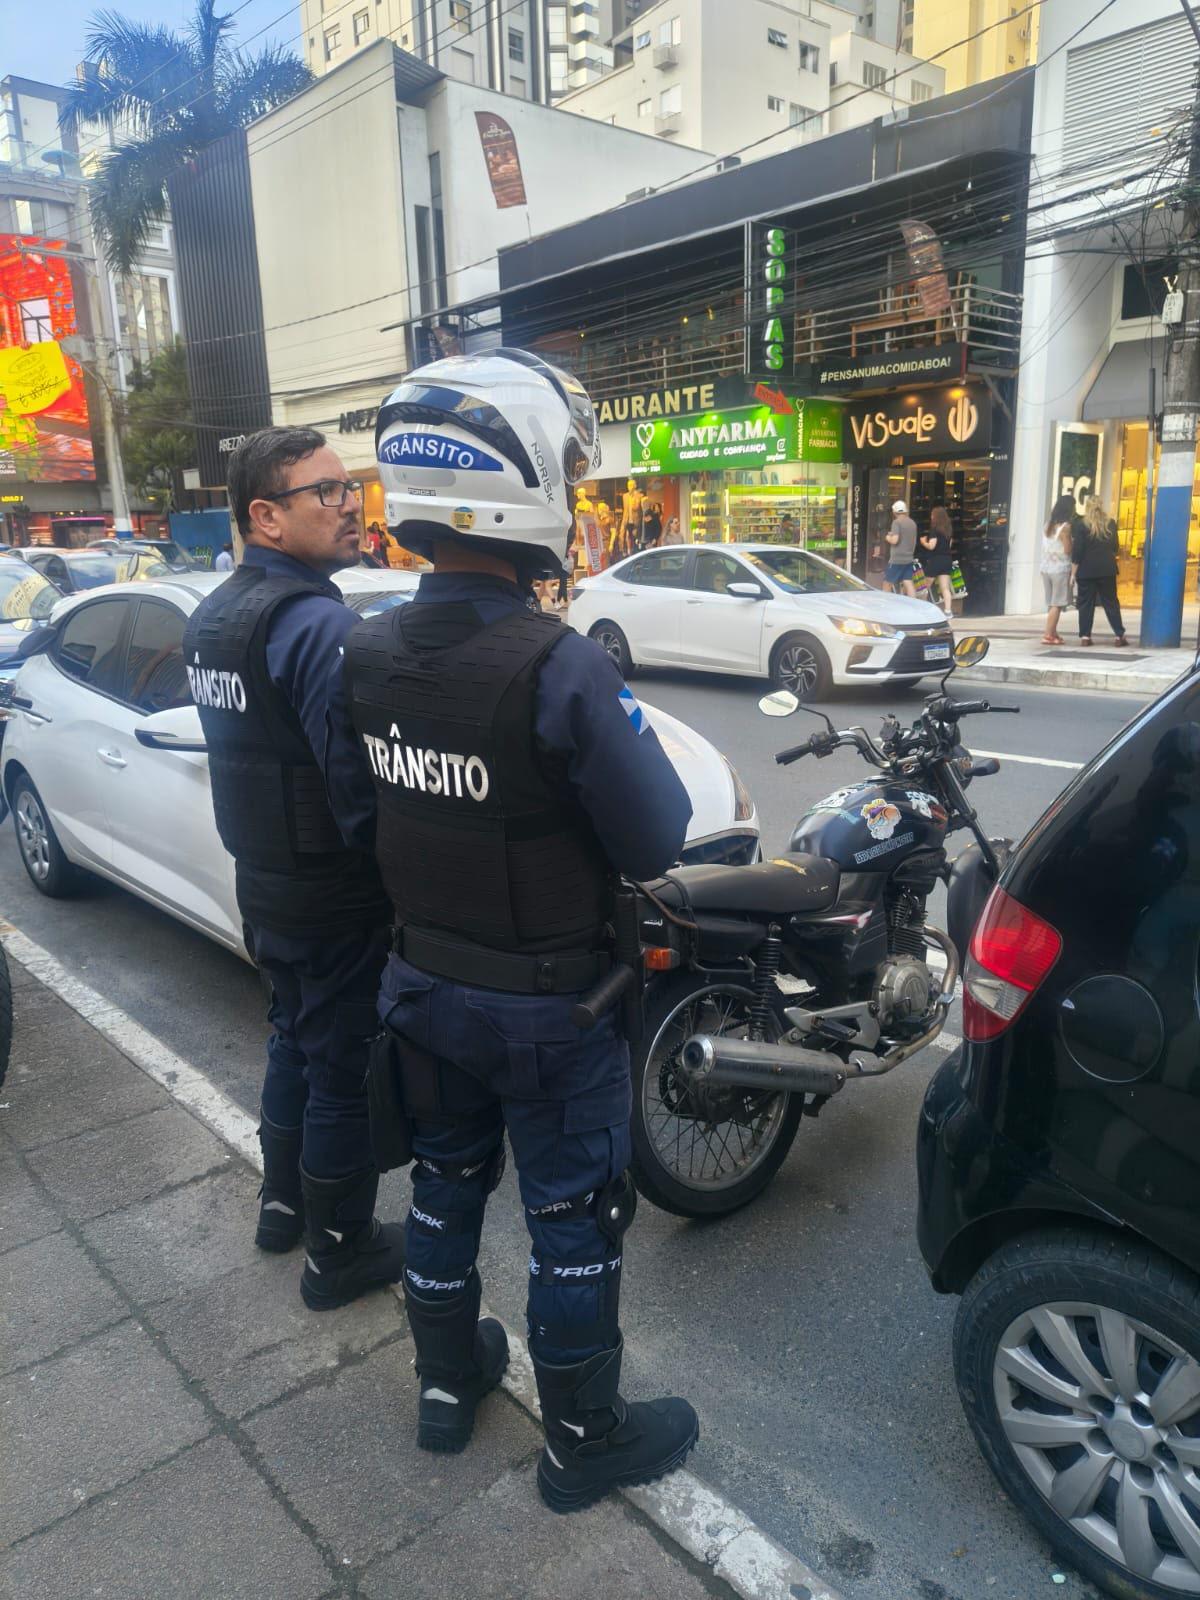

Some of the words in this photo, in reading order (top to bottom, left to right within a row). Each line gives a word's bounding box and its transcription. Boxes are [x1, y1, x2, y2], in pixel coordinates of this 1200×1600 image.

[765, 229, 786, 370] SOPAS
[820, 356, 951, 384] #PENSANUMACOMIDABOA!
[592, 383, 715, 423] AURANTE
[668, 416, 778, 449] ANYFARMA
[384, 434, 475, 469] TRÂNSITO
[679, 449, 709, 460] CUIDADO
[714, 447, 720, 456] E
[723, 443, 767, 456] CONFIANÇA
[531, 441, 555, 505] NORISK
[363, 723, 489, 802] TRÂNSITO
